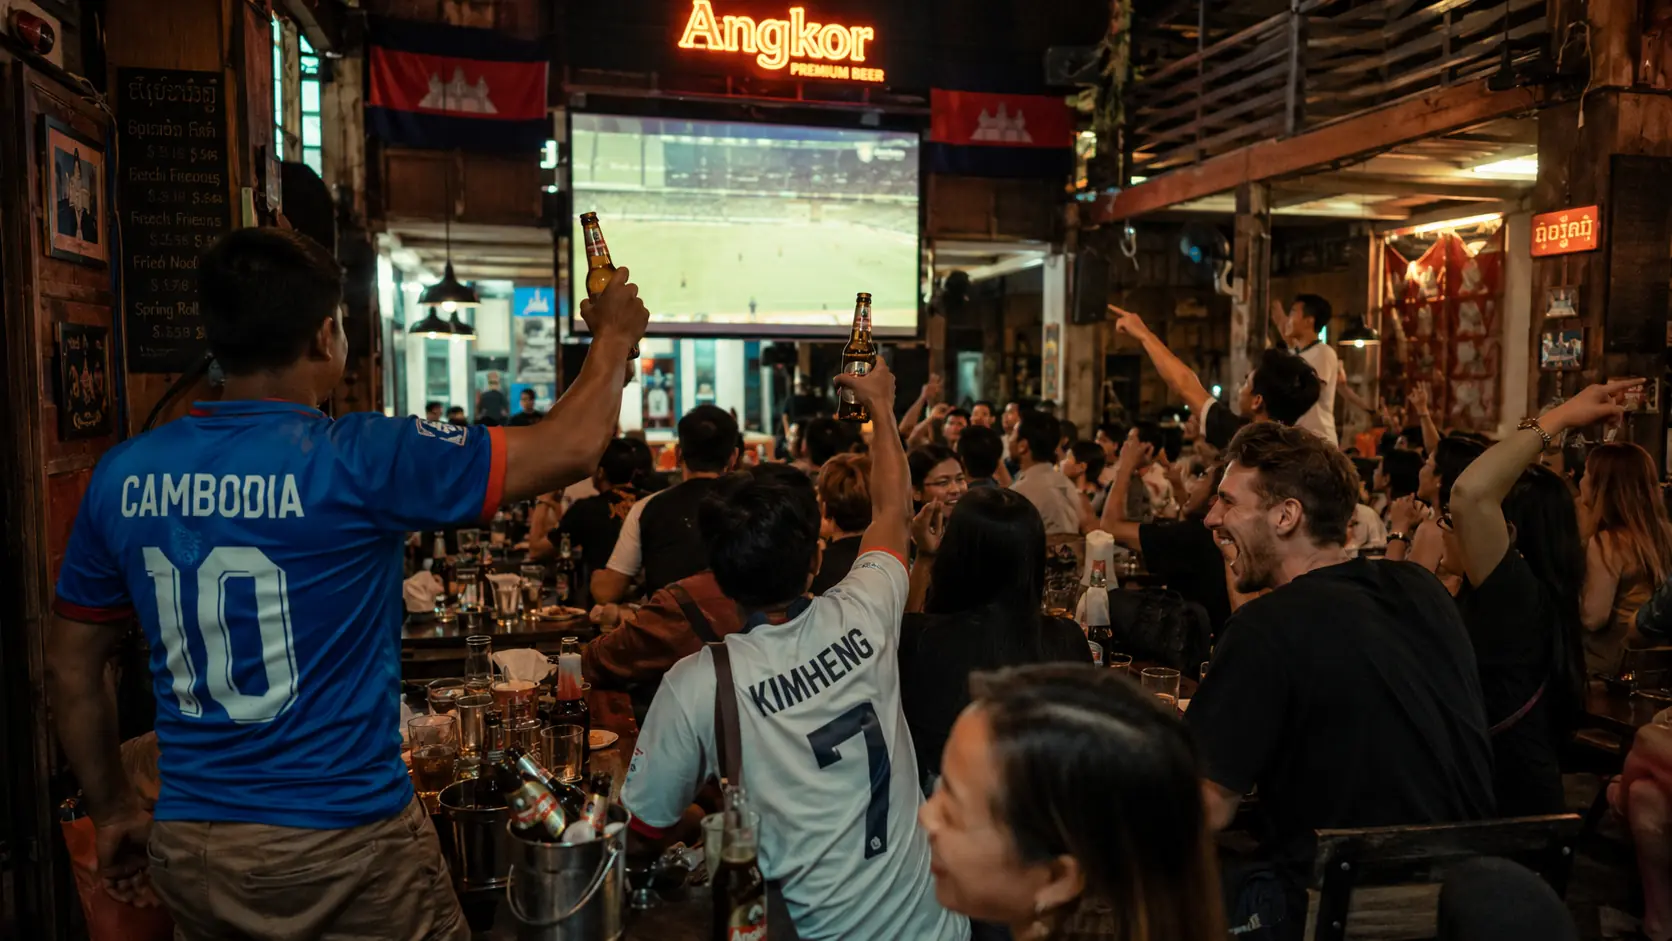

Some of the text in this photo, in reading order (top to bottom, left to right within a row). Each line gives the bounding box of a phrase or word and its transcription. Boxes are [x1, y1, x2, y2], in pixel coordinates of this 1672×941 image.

[678, 0, 874, 70] Angkor
[790, 62, 885, 82] PREMIUM BEER
[135, 300, 173, 322] Spring
[121, 473, 305, 519] CAMBODIA
[142, 546, 299, 725] 10
[749, 628, 874, 717] KIMHENG
[807, 702, 891, 860] 7
